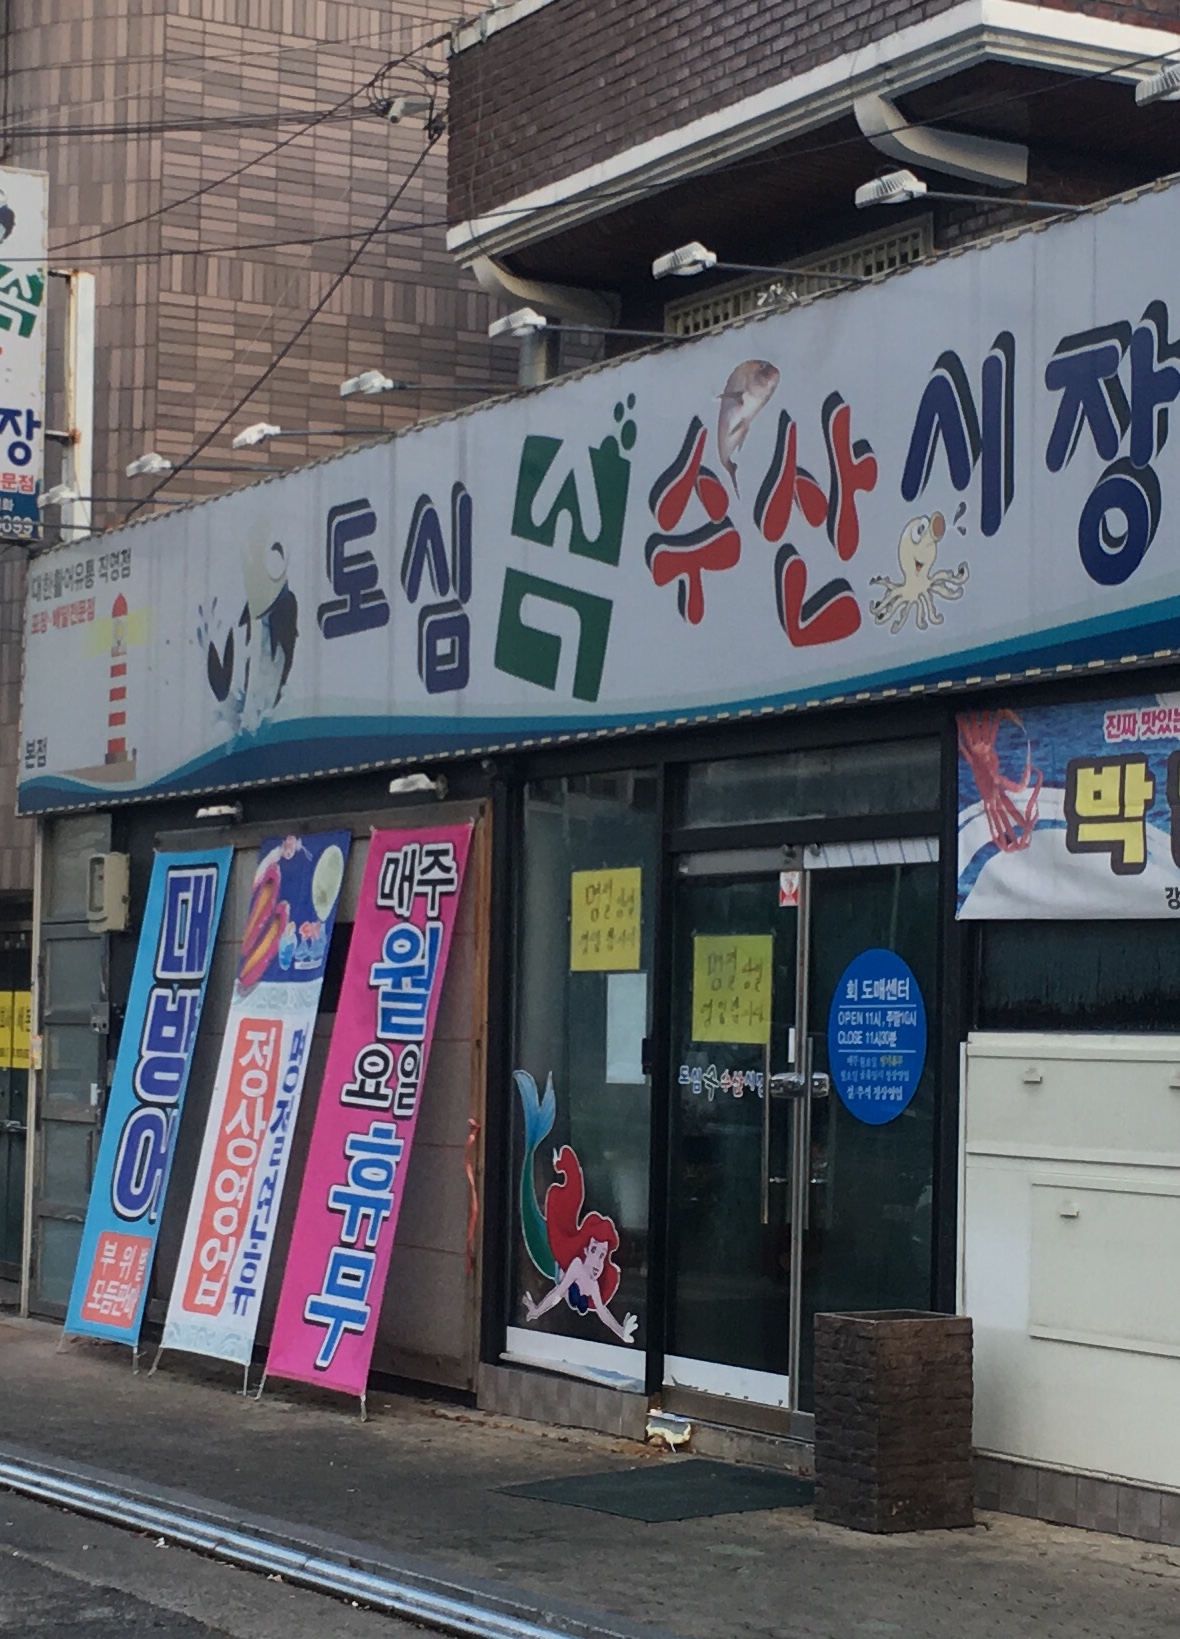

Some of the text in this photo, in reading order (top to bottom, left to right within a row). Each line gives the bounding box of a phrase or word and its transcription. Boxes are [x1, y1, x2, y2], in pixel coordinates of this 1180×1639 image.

[1105, 712, 1138, 739] 진짜
[25, 737, 48, 770] 본점
[377, 842, 458, 916] 매주
[845, 977, 910, 1001] 회 도매센터
[838, 1011, 863, 1026] OPEN
[837, 1030, 863, 1045] CLOSE
[194, 1026, 277, 1308] 정상영업
[305, 1121, 404, 1369] 휴무
